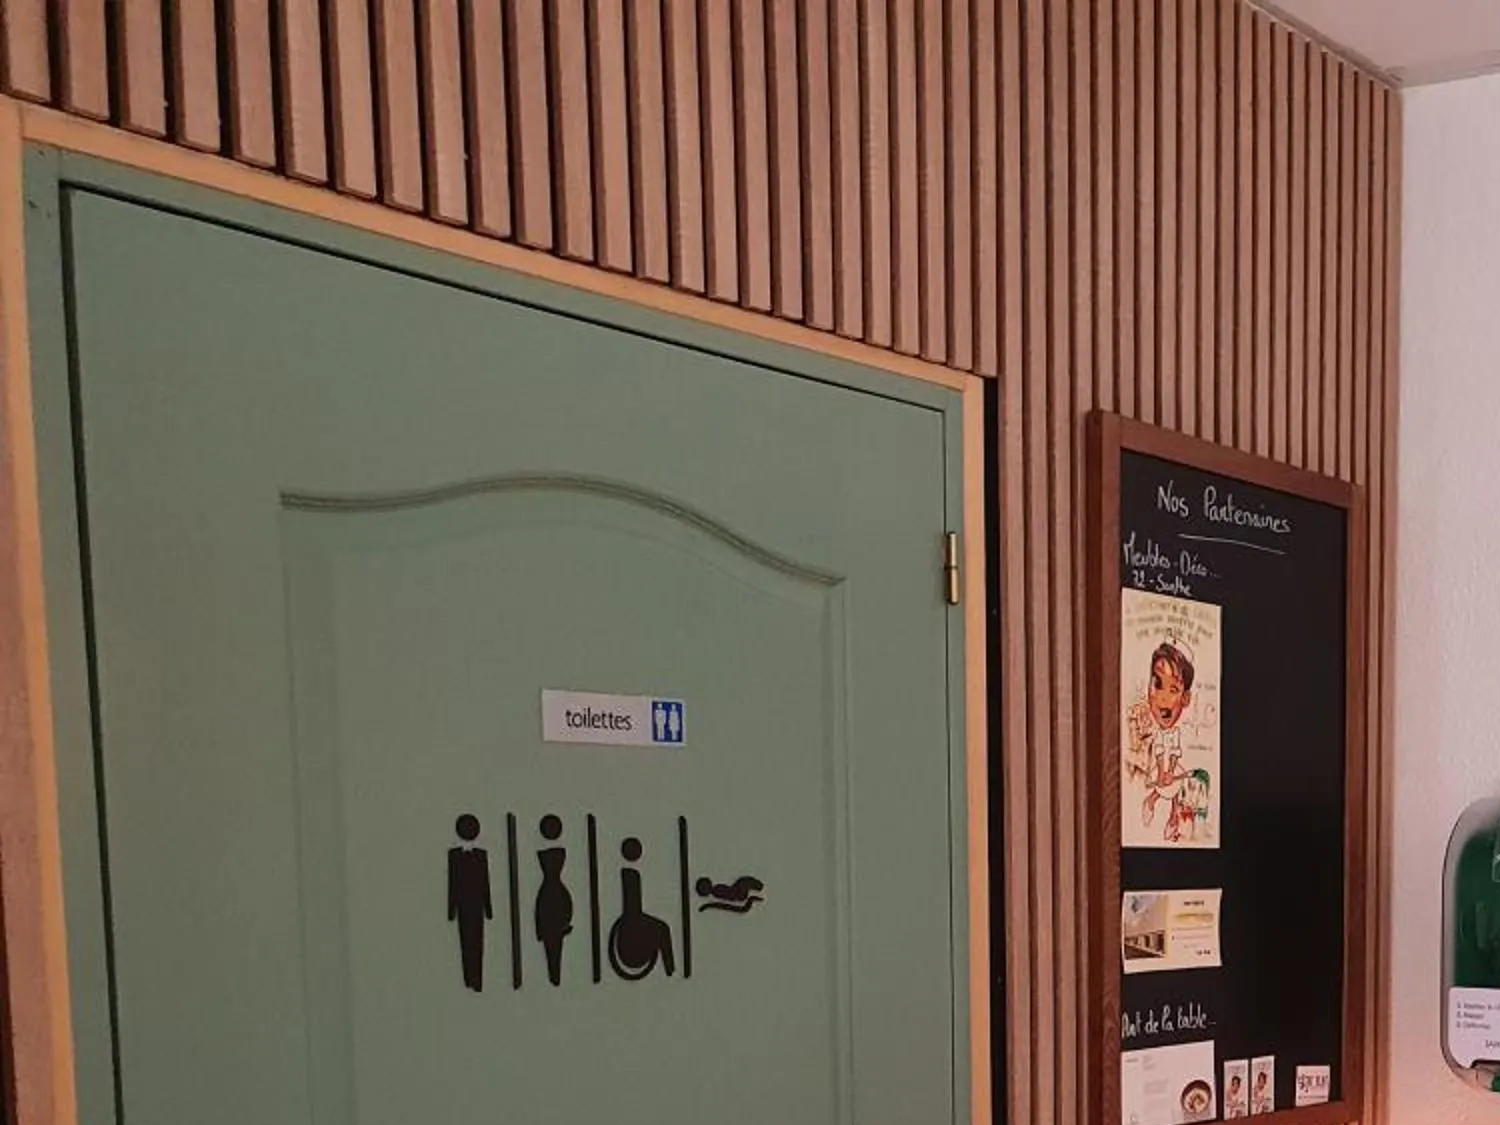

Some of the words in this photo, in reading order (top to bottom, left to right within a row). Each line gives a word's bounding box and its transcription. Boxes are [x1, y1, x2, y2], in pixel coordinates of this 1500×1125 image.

[1156, 479, 1190, 518] Nos
[1203, 484, 1292, 534] Partenaires
[565, 706, 633, 731] toilettes
[1144, 1008, 1160, 1034] de
[1161, 1004, 1175, 1032] la
[1177, 1001, 1207, 1029] table
